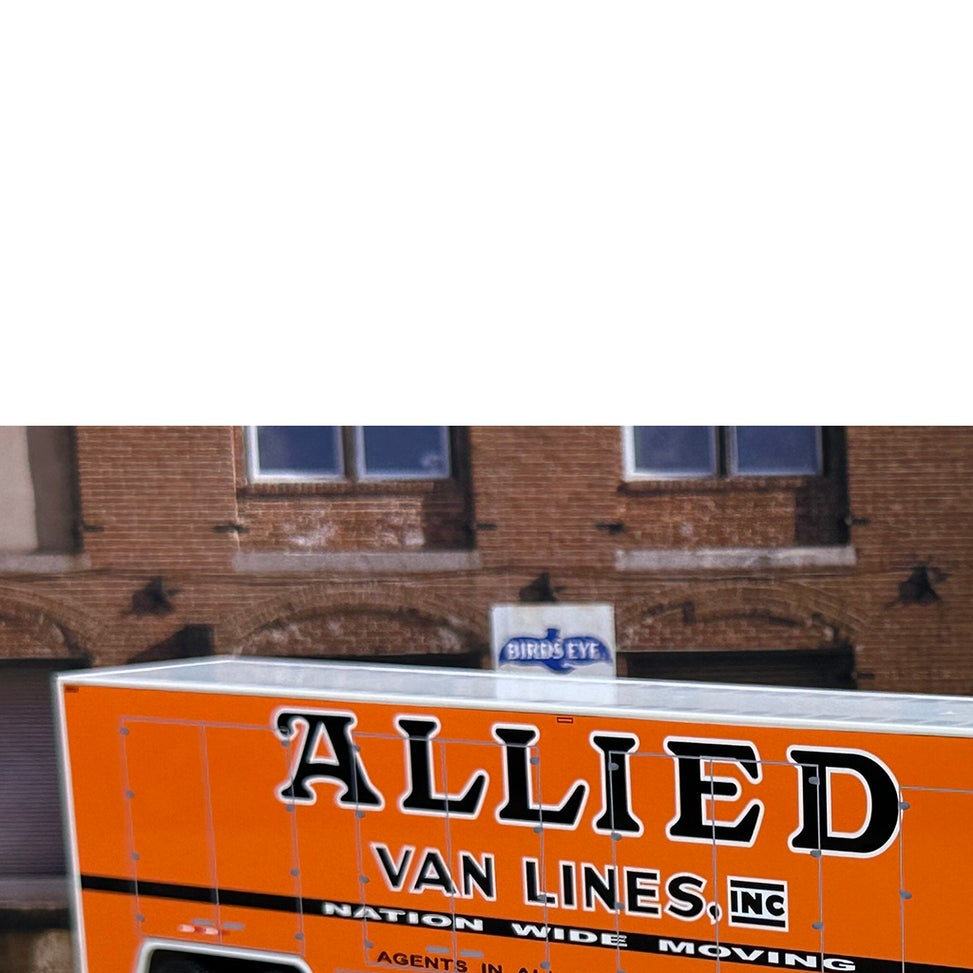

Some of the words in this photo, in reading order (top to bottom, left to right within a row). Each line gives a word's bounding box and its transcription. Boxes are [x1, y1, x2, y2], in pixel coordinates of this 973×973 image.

[567, 642, 600, 660] EYE
[275, 709, 902, 856] ALLIED
[371, 842, 496, 900] VAN
[521, 856, 723, 924] LINES,
[730, 888, 786, 919] INC
[321, 902, 484, 933] NATION
[512, 923, 628, 947] WIDE
[658, 939, 857, 973] MOVING
[377, 951, 468, 973] AGENTS
